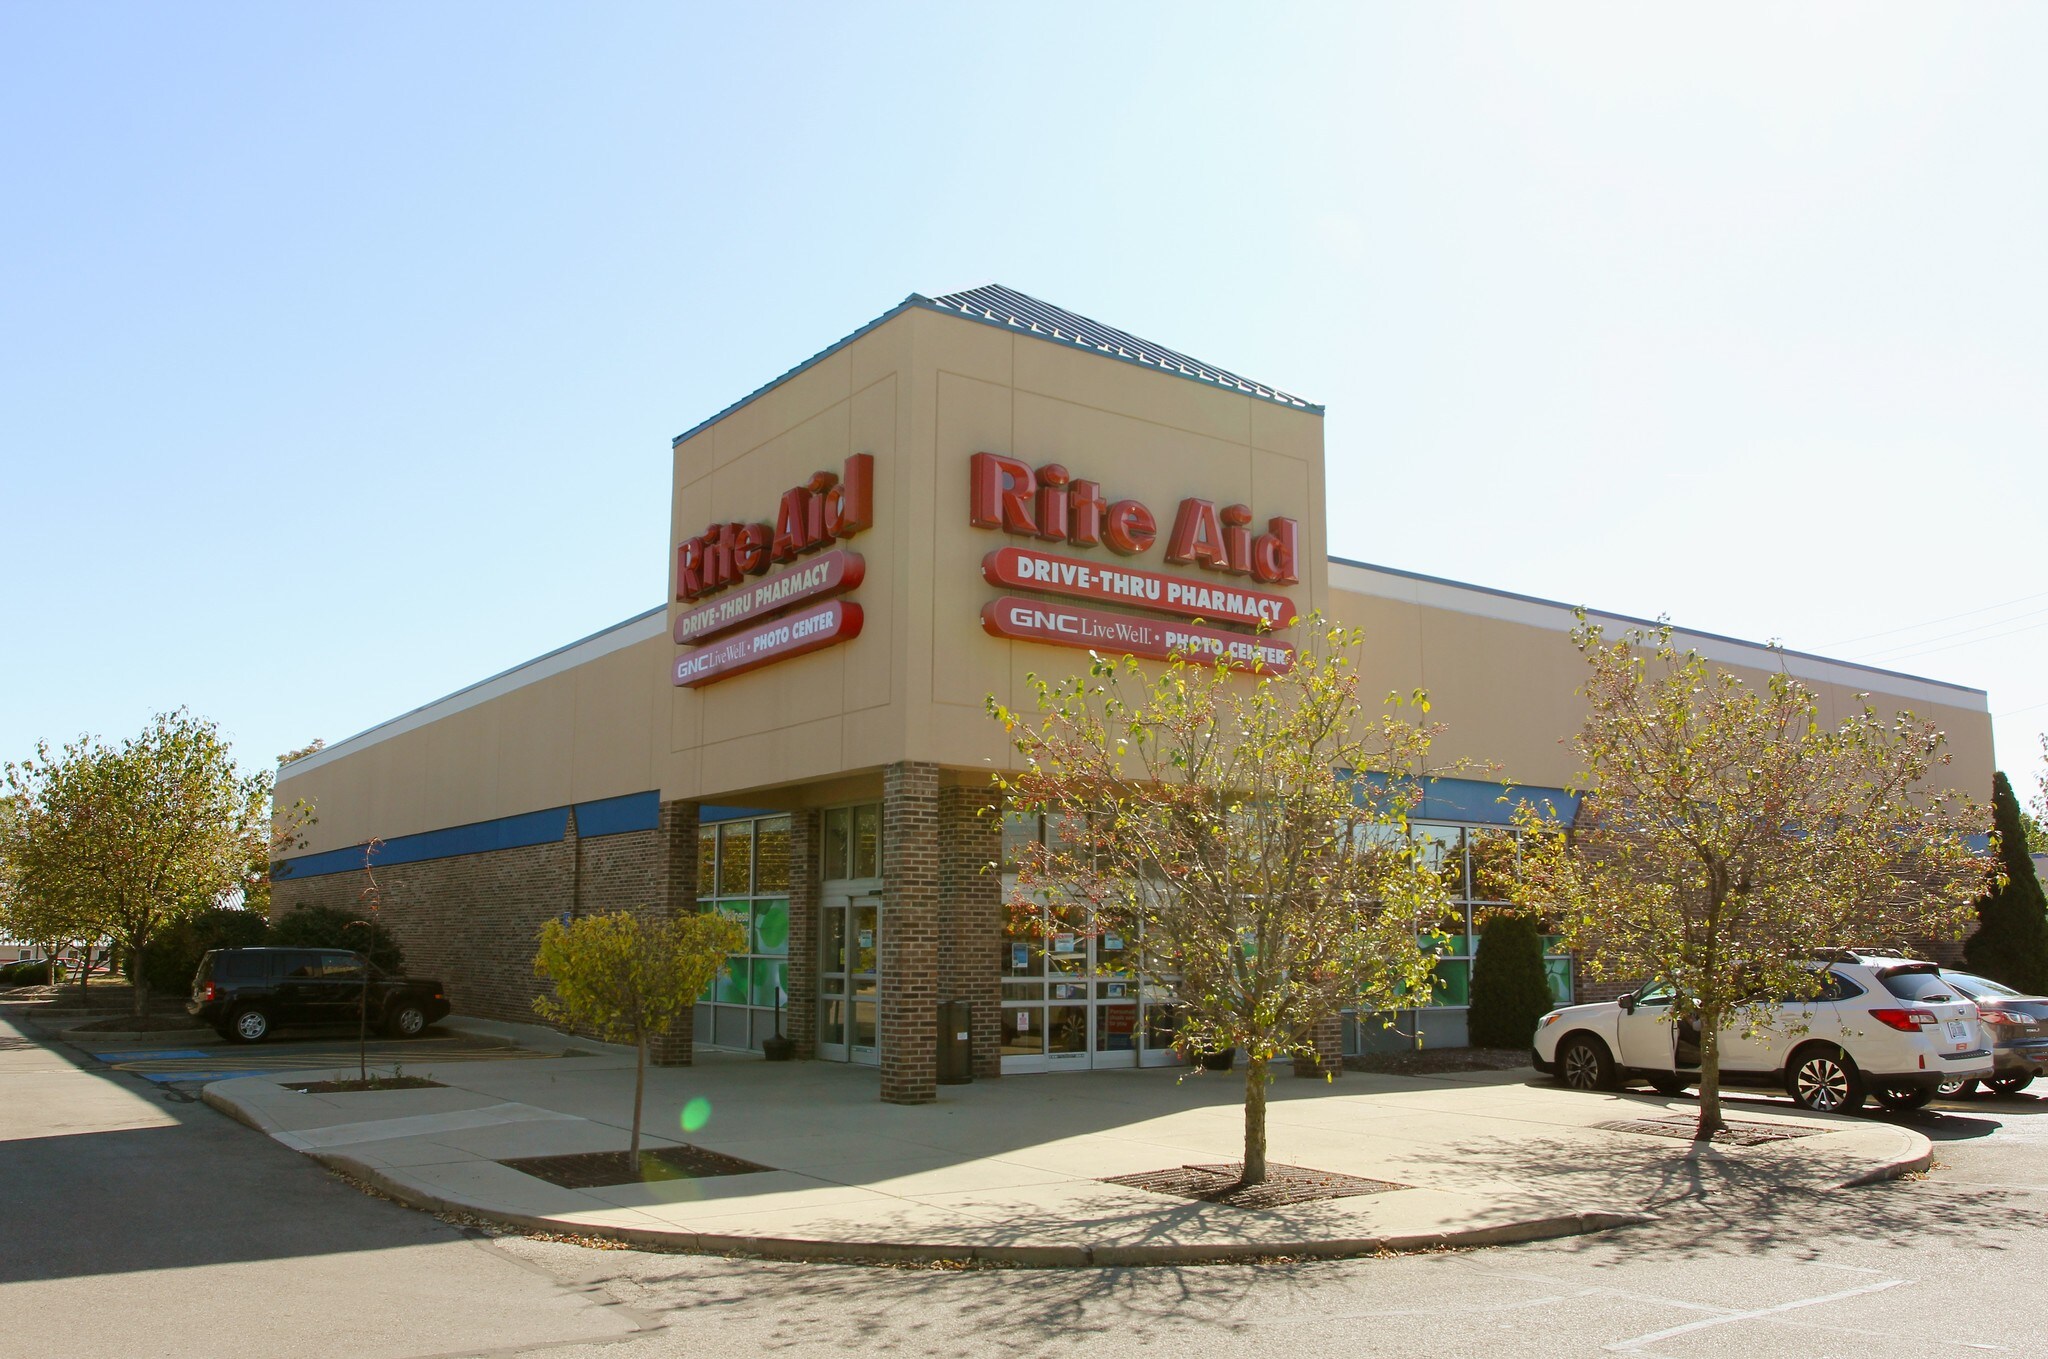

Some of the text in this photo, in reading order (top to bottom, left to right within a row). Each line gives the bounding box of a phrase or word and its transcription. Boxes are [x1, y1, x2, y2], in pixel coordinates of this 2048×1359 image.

[676, 453, 874, 603] Rite Aid
[970, 452, 1299, 586] Rite Aid
[683, 561, 830, 636] DRIVE-THRU PHARMACY
[1017, 556, 1283, 621] DRIVE-THRU PHARMACY
[678, 654, 709, 678] GNC
[753, 626, 789, 653] PHOTO
[792, 610, 834, 639] CENTER
[1010, 607, 1078, 634] GNC
[1165, 631, 1224, 656] PHOTO
[1228, 641, 1287, 665] CENTER
